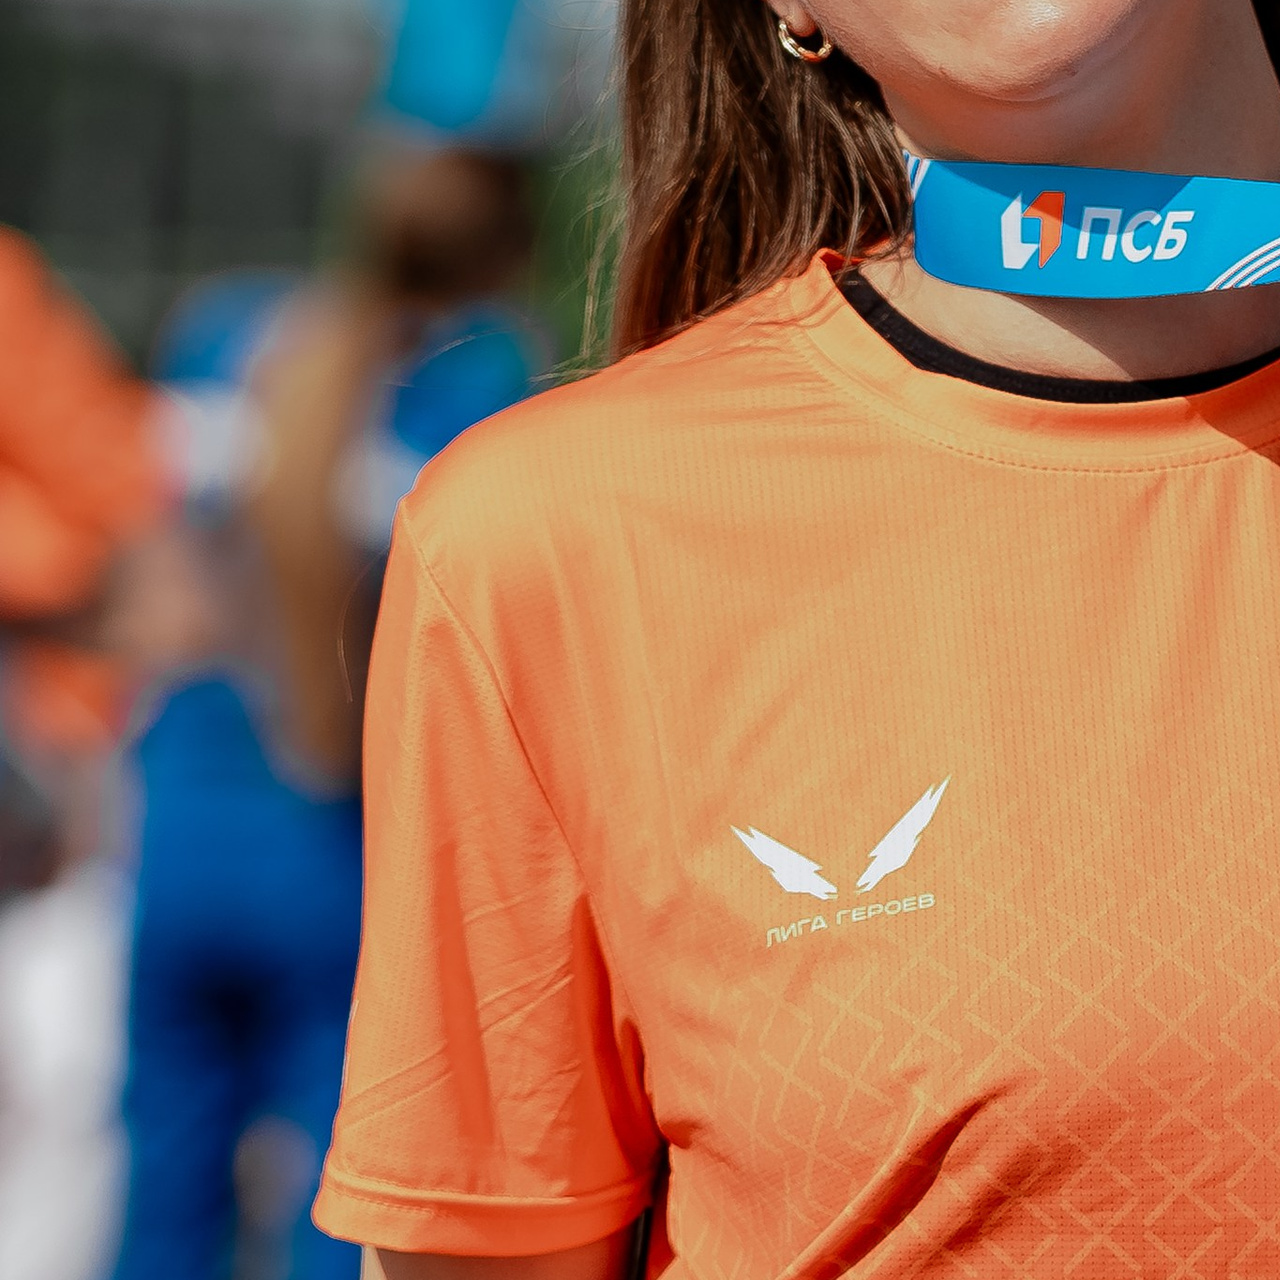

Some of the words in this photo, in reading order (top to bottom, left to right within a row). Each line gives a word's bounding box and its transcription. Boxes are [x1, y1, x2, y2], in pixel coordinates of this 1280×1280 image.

[1076, 205, 1196, 263] ПСБ
[766, 915, 828, 948] ЛИГА
[836, 892, 936, 925] ГЕРОЕВ
